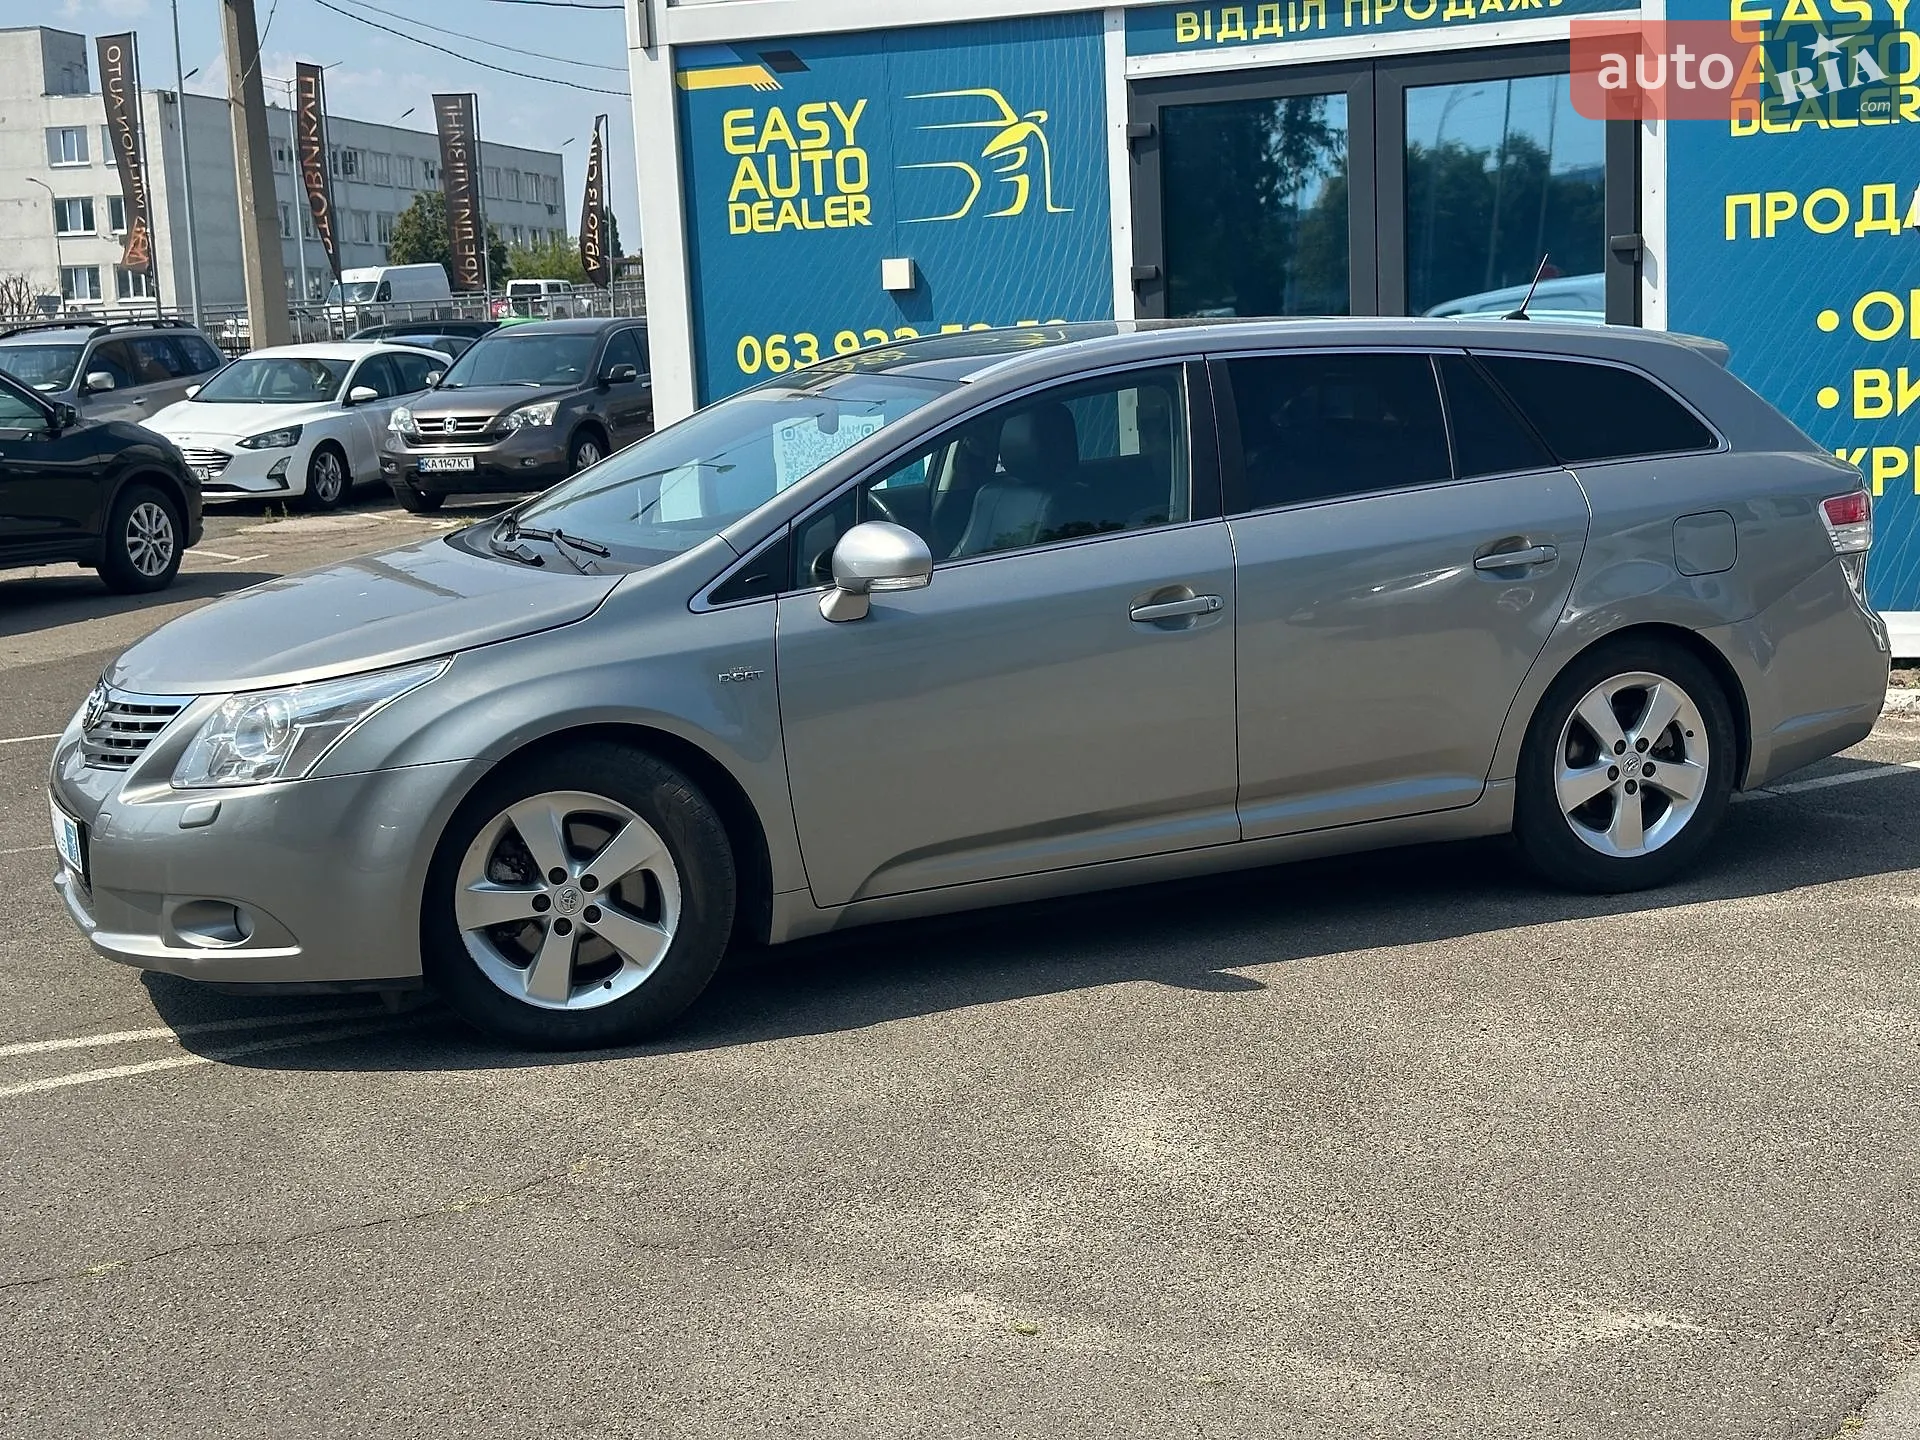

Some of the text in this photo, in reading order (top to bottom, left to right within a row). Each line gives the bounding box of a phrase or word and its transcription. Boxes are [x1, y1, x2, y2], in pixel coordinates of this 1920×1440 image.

[1176, 0, 1327, 43] ВІДДІЛ
[723, 99, 868, 154] EASY
[728, 147, 869, 202] AUTO
[728, 194, 873, 234] DEALER
[1852, 288, 1920, 341] О
[736, 332, 820, 374] 063
